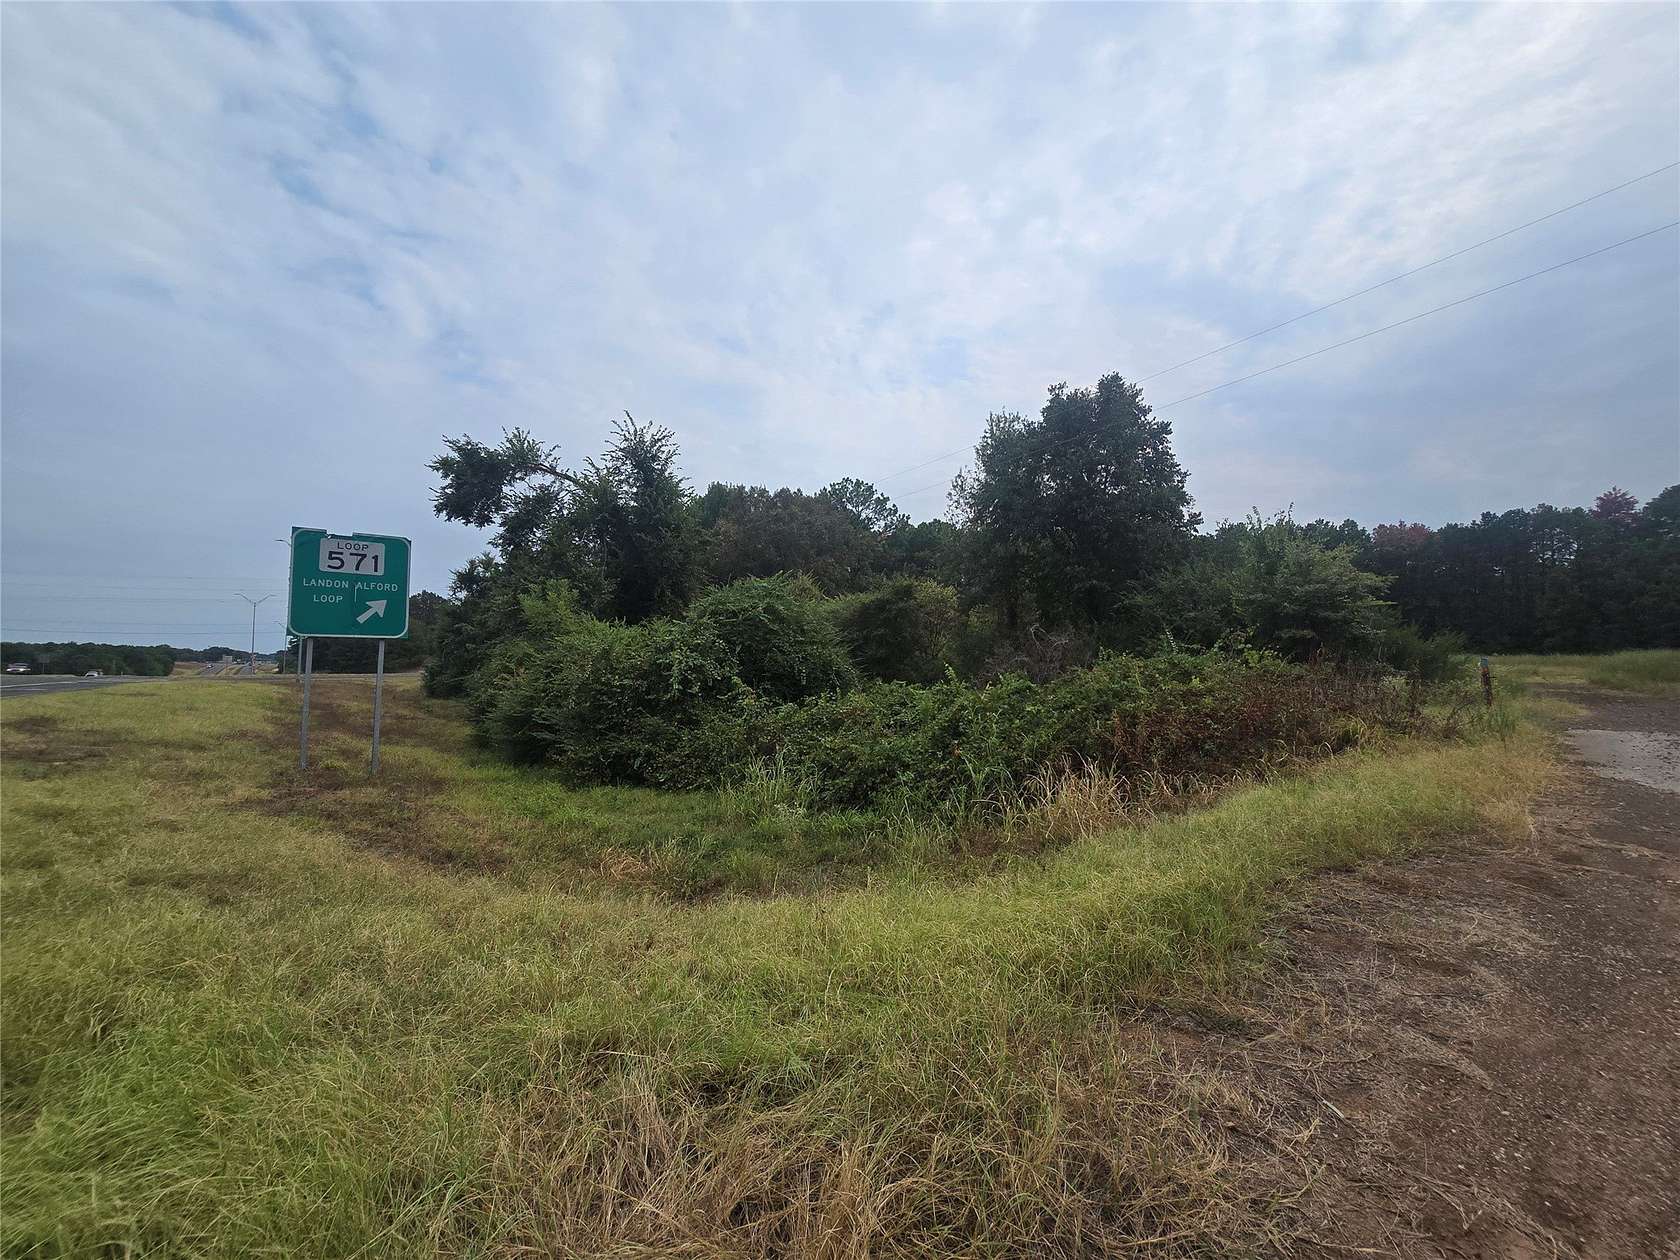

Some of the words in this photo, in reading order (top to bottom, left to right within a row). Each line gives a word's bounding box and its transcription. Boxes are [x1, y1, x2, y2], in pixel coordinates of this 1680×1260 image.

[337, 542, 369, 551] LOOP
[327, 550, 379, 573] 571
[303, 578, 349, 588] LANDON
[355, 582, 398, 592] ALFORD
[313, 594, 343, 603] LOOP
